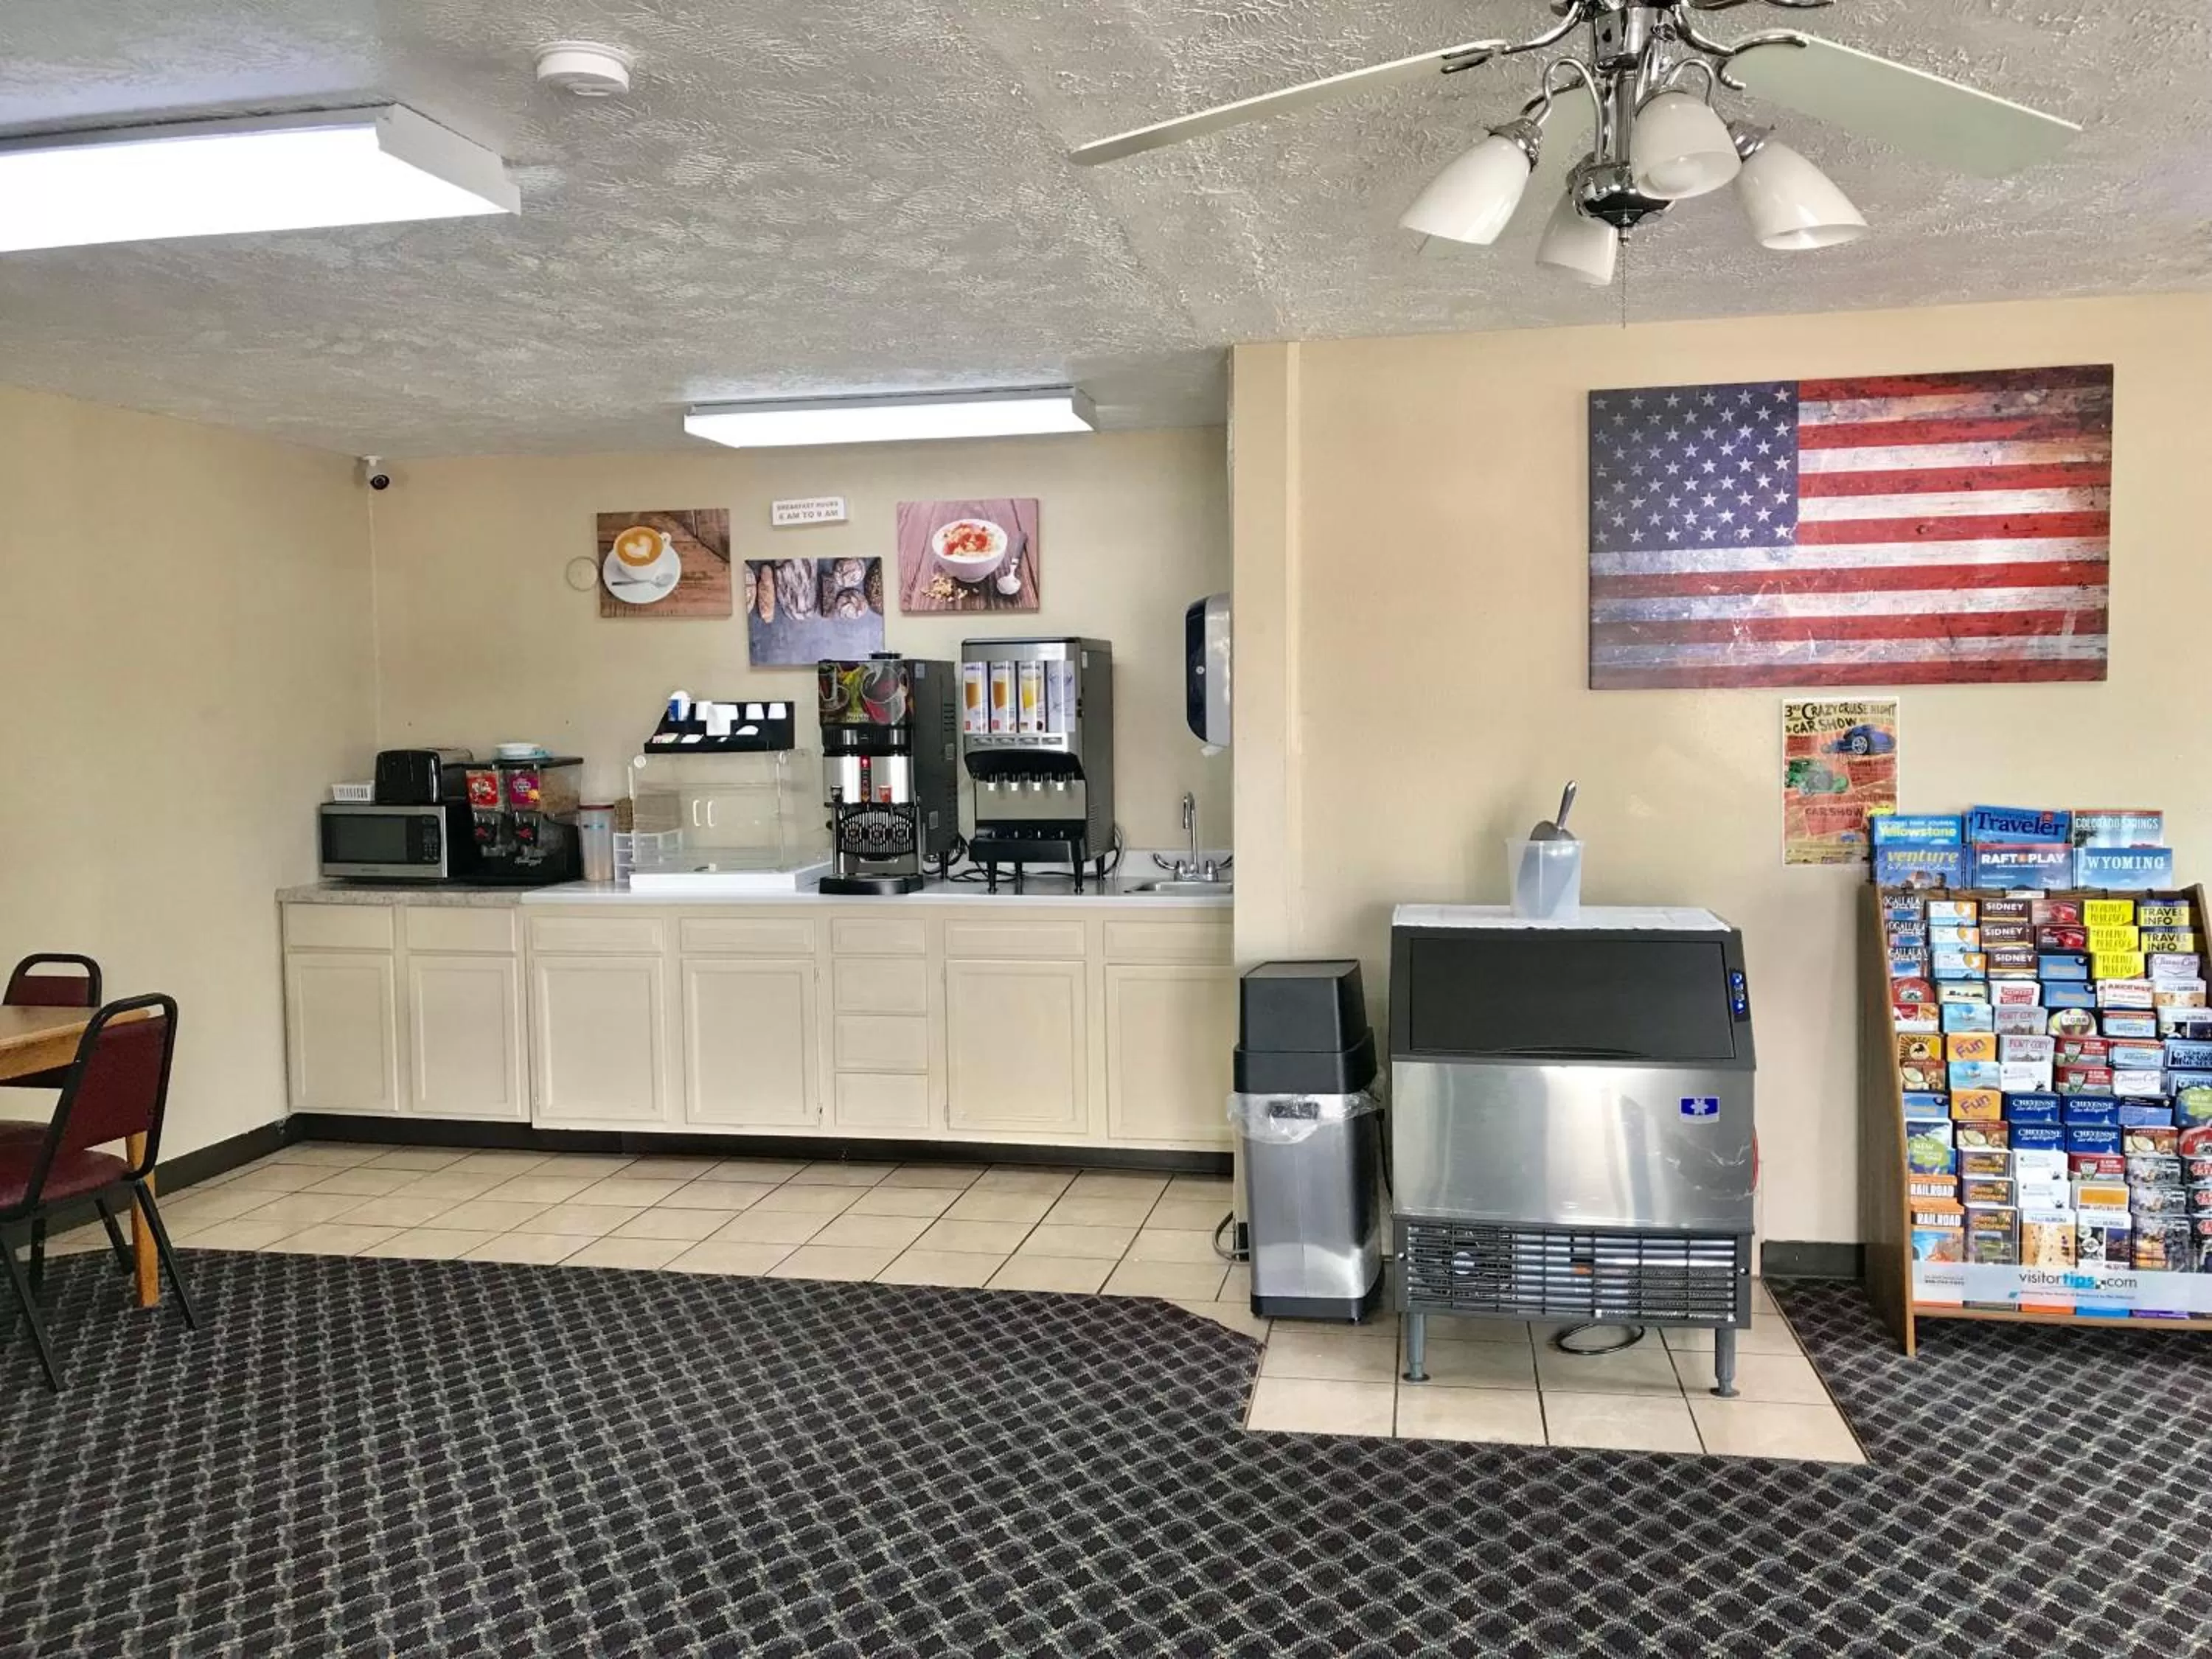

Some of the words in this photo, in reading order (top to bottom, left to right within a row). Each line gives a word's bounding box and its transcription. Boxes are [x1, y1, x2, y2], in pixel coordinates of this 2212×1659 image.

[1801, 703, 1837, 720] CRAZY
[1838, 702, 1868, 716] CRUISE
[1792, 720, 1818, 734] CAR
[1818, 717, 1857, 733] SHOW
[1805, 807, 1828, 816] CAR
[1829, 807, 1864, 817] SHOW
[1976, 812, 2065, 835] Traveler
[2075, 816, 2119, 830] COLORADO
[1879, 825, 1958, 838] Yellowstone
[1886, 849, 1959, 863] venture
[1981, 853, 2017, 864] RAFT
[2028, 853, 2065, 864] PLAY
[2087, 855, 2166, 870] WYOMING
[1986, 902, 2024, 912] SIDNEY
[2143, 908, 2183, 917] TRAVEL
[2146, 917, 2173, 926] INFO
[1984, 927, 2023, 936] SIDNEY
[2147, 933, 2188, 942] TRAVEL
[2147, 942, 2177, 952] INFO
[1994, 953, 2034, 963] SIDNEY
[1955, 1038, 1986, 1058] Fun
[1961, 1094, 1991, 1114] Fun
[2012, 1099, 2056, 1108] CHEYENNE
[2070, 1100, 2114, 1110] CHEYENNE
[2018, 1129, 2062, 1138] CHEYENNE
[2073, 1130, 2118, 1139] CHEYENNE
[1916, 1213, 1961, 1226] RAILROAD
